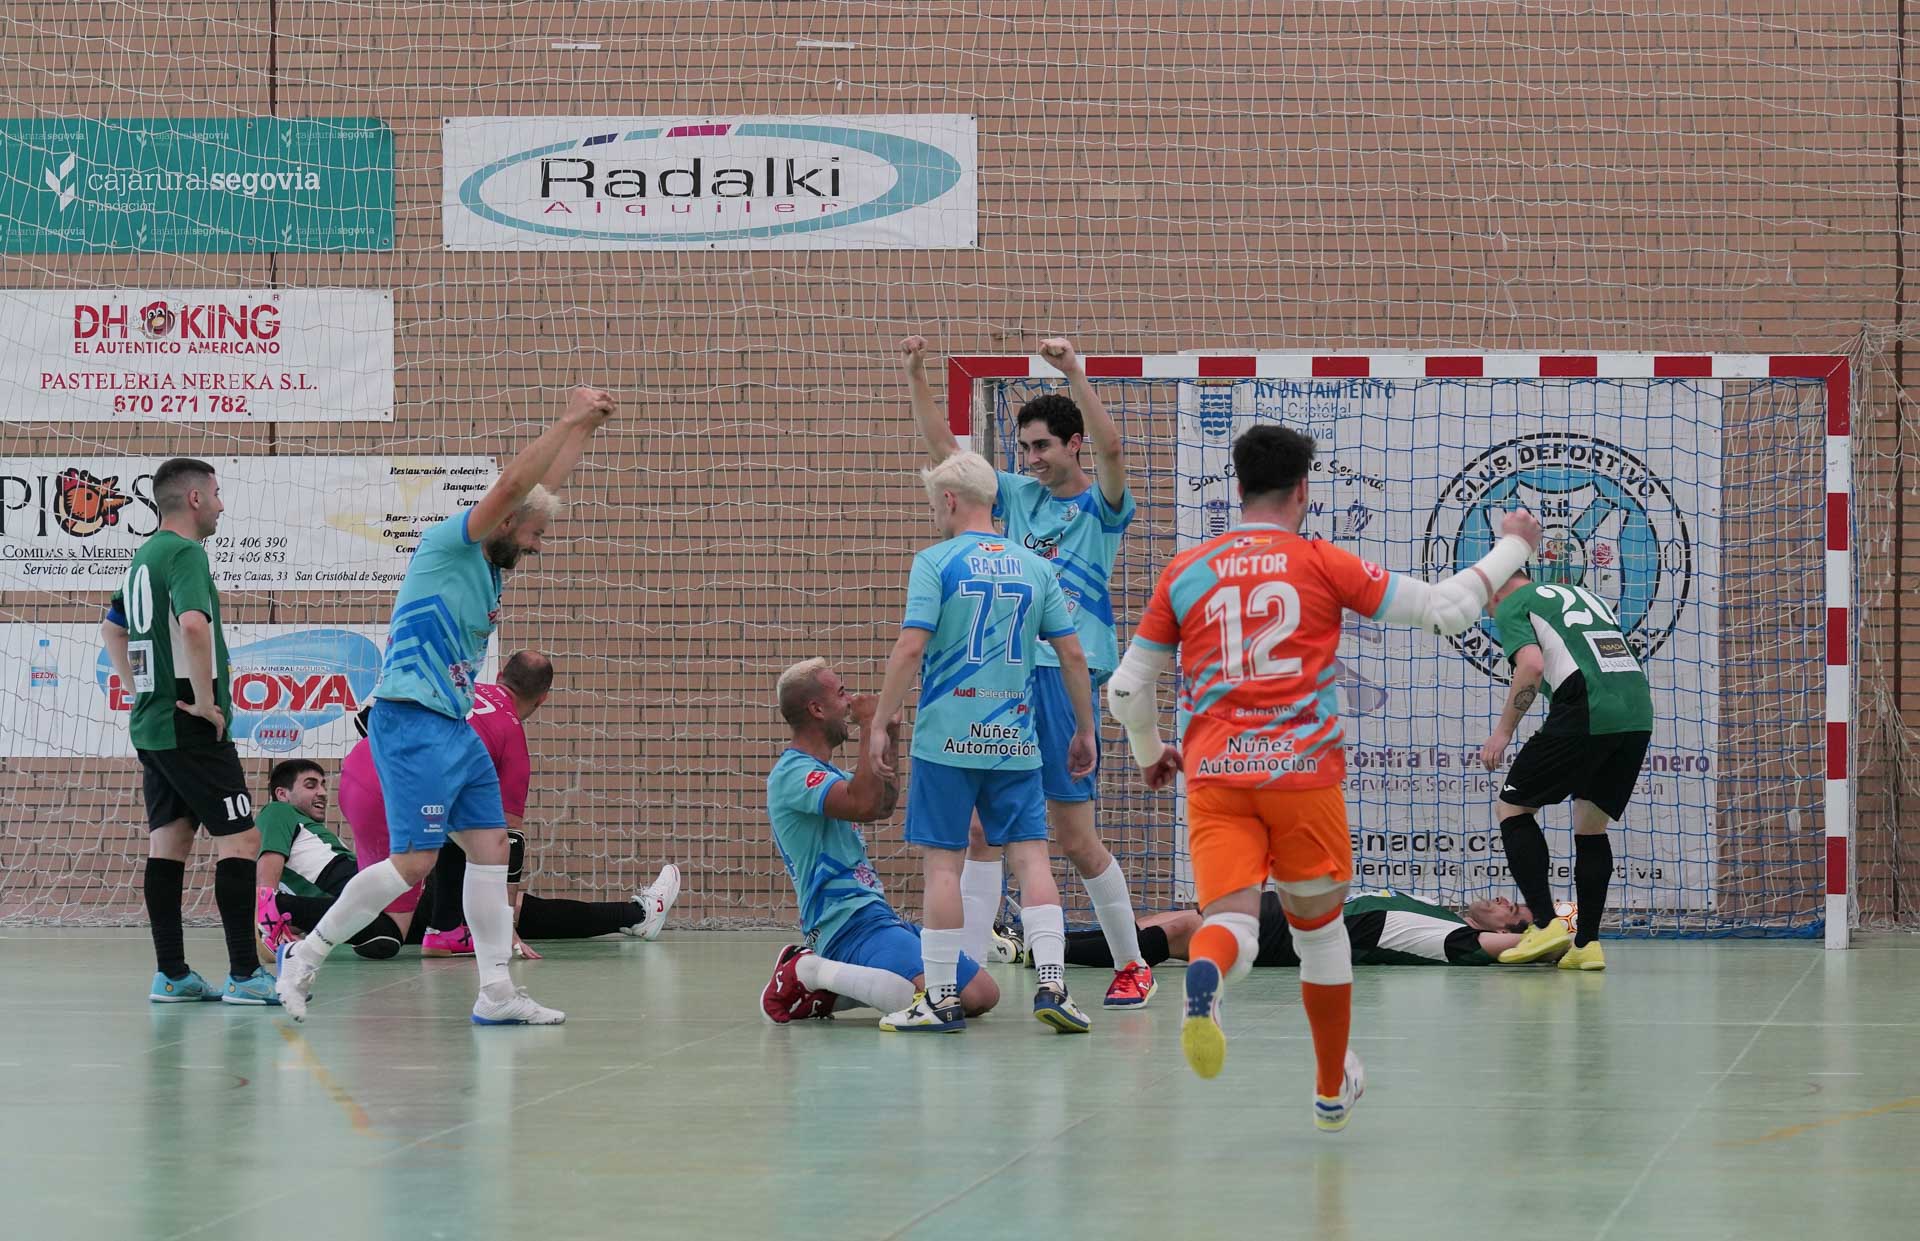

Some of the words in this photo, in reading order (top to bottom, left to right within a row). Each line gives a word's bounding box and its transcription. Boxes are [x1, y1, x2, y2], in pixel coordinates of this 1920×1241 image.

[87, 167, 321, 197] cajaruralsegovia
[540, 157, 841, 198] Radalki
[544, 200, 840, 217] Alquiler
[74, 342, 89, 354] EL
[95, 341, 181, 354] AUTENTICO
[187, 341, 280, 354] AMERICANO
[182, 373, 274, 390] NEREKA
[279, 373, 318, 390] S.L.
[1254, 379, 1396, 399] AYUNTAMIENTO
[114, 395, 153, 413] 670
[161, 395, 198, 413] 271
[208, 395, 247, 413] 782
[390, 466, 447, 475] Restauración
[1455, 455, 1512, 503] CLUB
[1518, 443, 1655, 498] DEPORTIVO
[215, 536, 236, 548] 921
[240, 536, 262, 549] 406
[264, 536, 288, 548] 390
[2, 545, 64, 558] COMIDAS
[68, 547, 77, 558] &
[82, 545, 137, 558] MERIEN
[215, 551, 235, 563] 921
[238, 551, 260, 563] 406
[264, 551, 286, 563] 853
[23, 563, 68, 575] Servicio
[71, 563, 85, 575] de
[1216, 553, 1288, 578] VÍCTOR
[223, 571, 242, 581] Tres
[244, 571, 274, 582] Casas,
[276, 571, 288, 581] 33
[295, 571, 313, 581] San
[315, 570, 357, 581] Cristóbal
[359, 570, 370, 581] de
[959, 579, 1033, 665] 77
[1204, 581, 1303, 683] 12
[953, 687, 976, 698] Audi
[978, 688, 1025, 699] Selection
[258, 729, 300, 742] muy
[970, 723, 1019, 739] Núñez
[944, 737, 1036, 755] Automoción
[1228, 737, 1294, 754] Núñez
[1429, 746, 1450, 769] la
[1426, 776, 1499, 793] Sociales
[223, 793, 250, 821] 10
[1433, 861, 1461, 877] de
